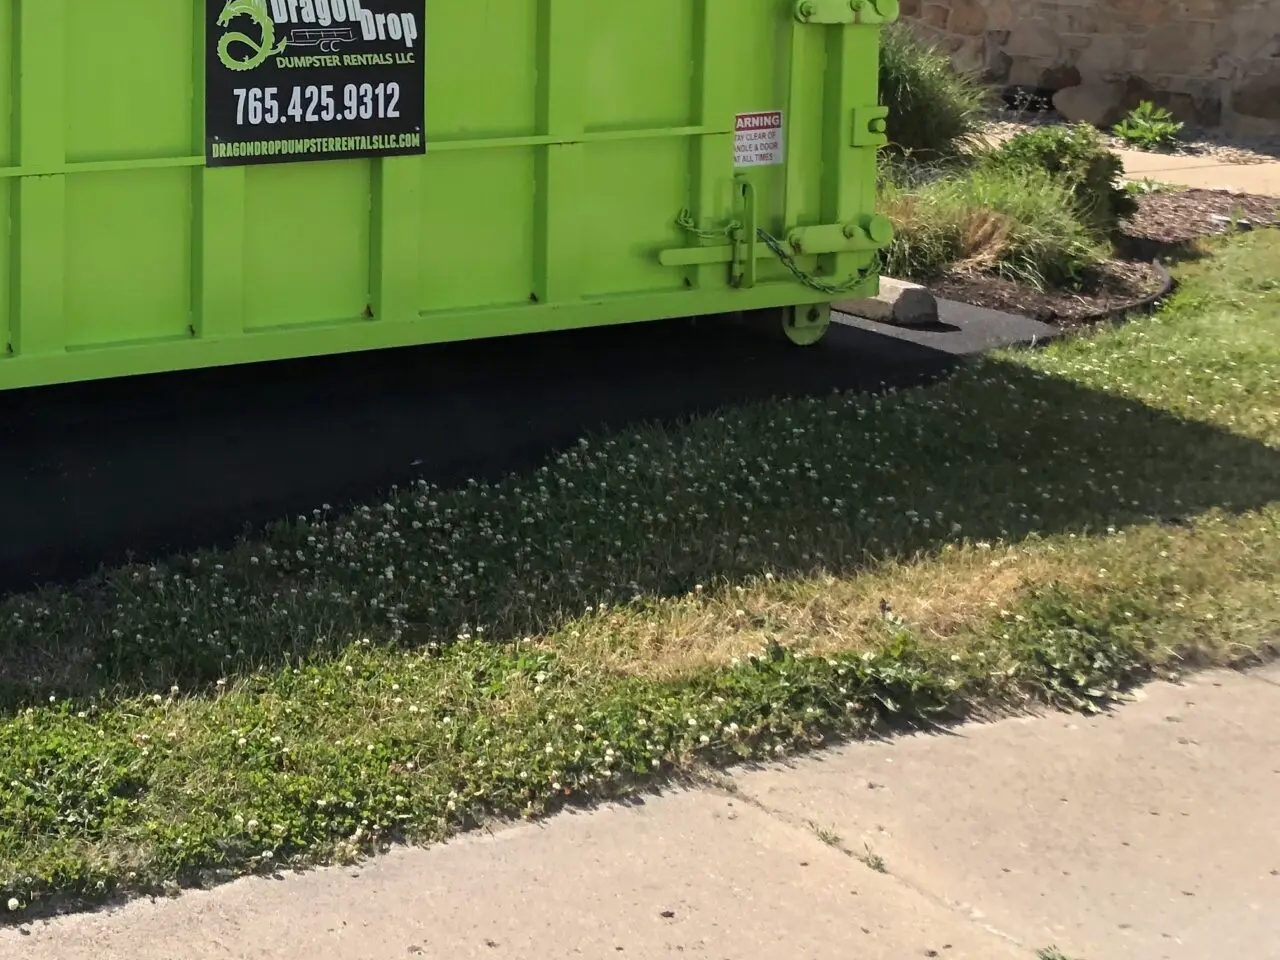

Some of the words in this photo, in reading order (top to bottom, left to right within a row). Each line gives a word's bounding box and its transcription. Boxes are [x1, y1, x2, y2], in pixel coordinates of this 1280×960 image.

[359, 8, 418, 48] Drop
[276, 55, 341, 69] DUMPSTER
[343, 53, 393, 66] RENTALS
[395, 52, 415, 64] LLC
[233, 81, 400, 126] 765.425.9312
[736, 115, 780, 128] ARNING
[746, 132, 767, 141] CLEAR
[767, 131, 776, 139] OF
[212, 132, 420, 158] DRAGONDROPDUMPSTERRENTALSLLC.COM
[735, 144, 753, 152] NDLE
[759, 142, 778, 150] DOOR
[755, 153, 773, 161] TIMES
